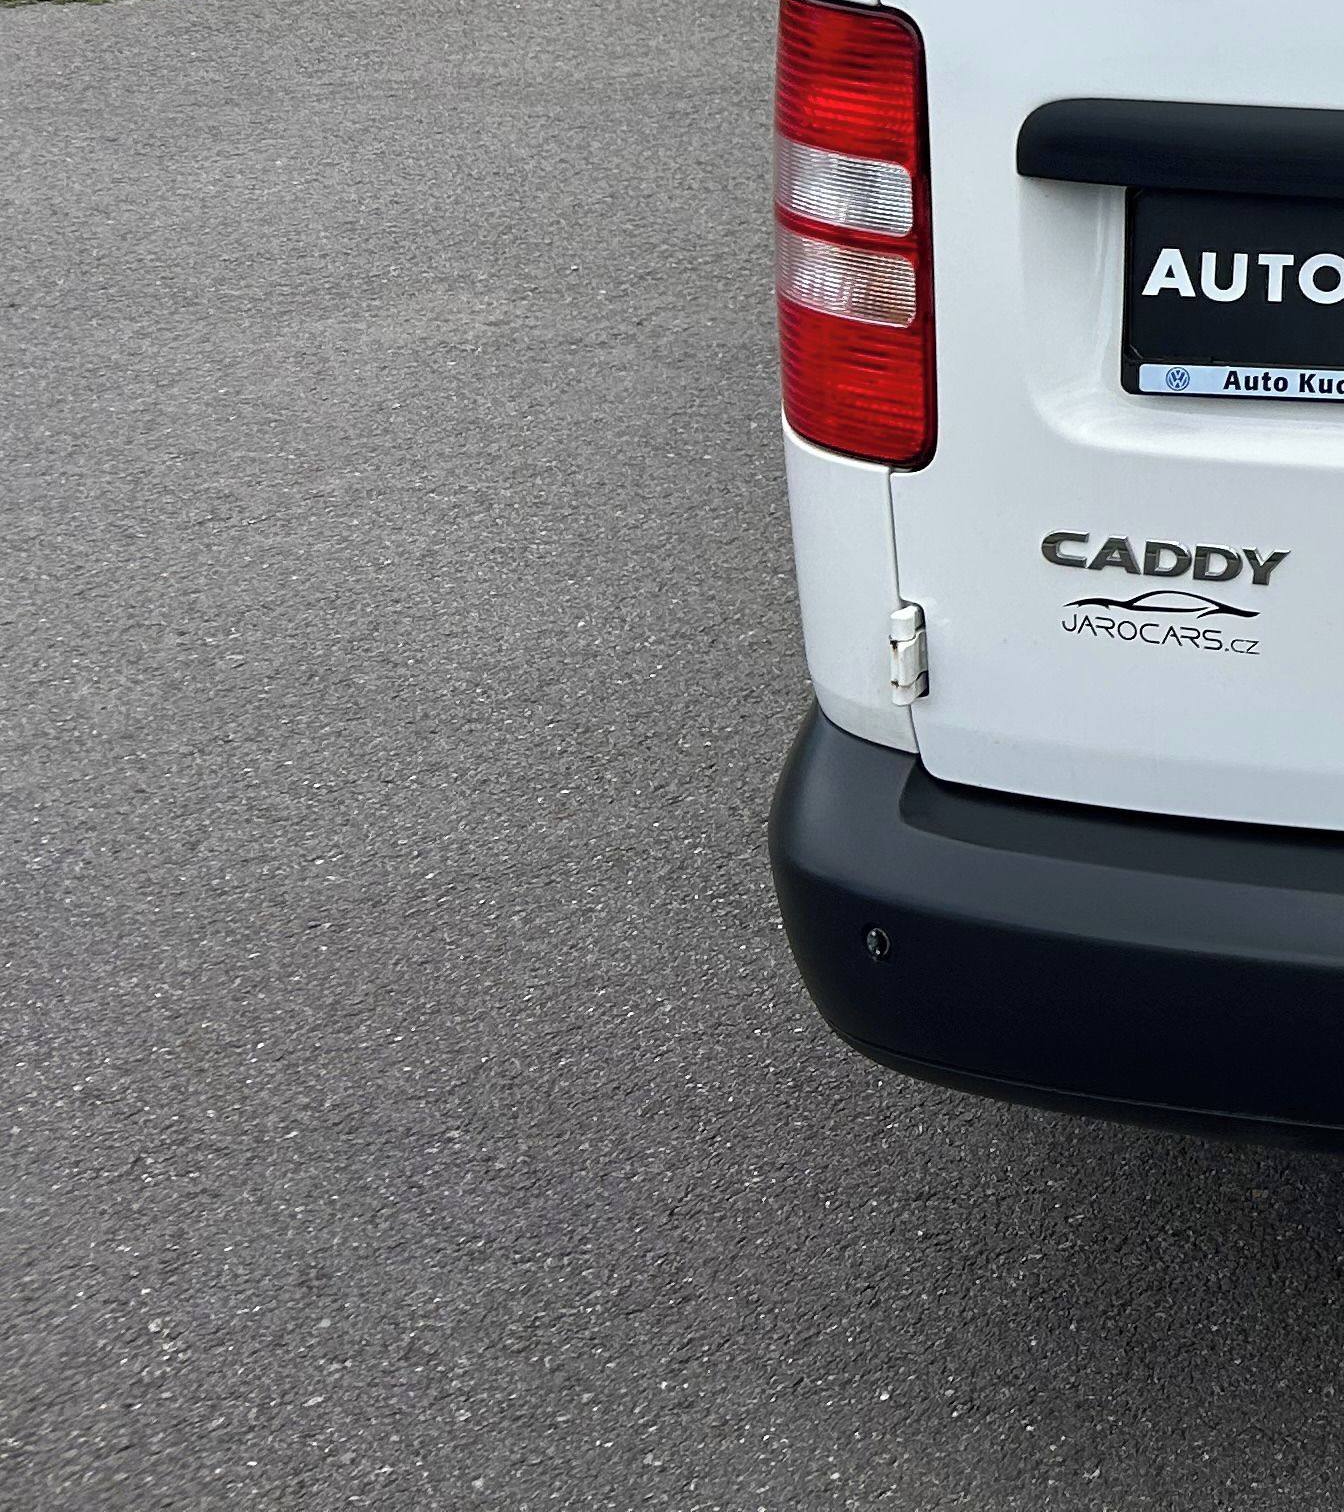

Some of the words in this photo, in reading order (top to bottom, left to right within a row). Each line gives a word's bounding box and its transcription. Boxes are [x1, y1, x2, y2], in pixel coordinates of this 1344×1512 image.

[1222, 370, 1289, 393] Auto
[1040, 529, 1292, 586] CADDY
[1061, 613, 1261, 655] JAROCARS.CZ
